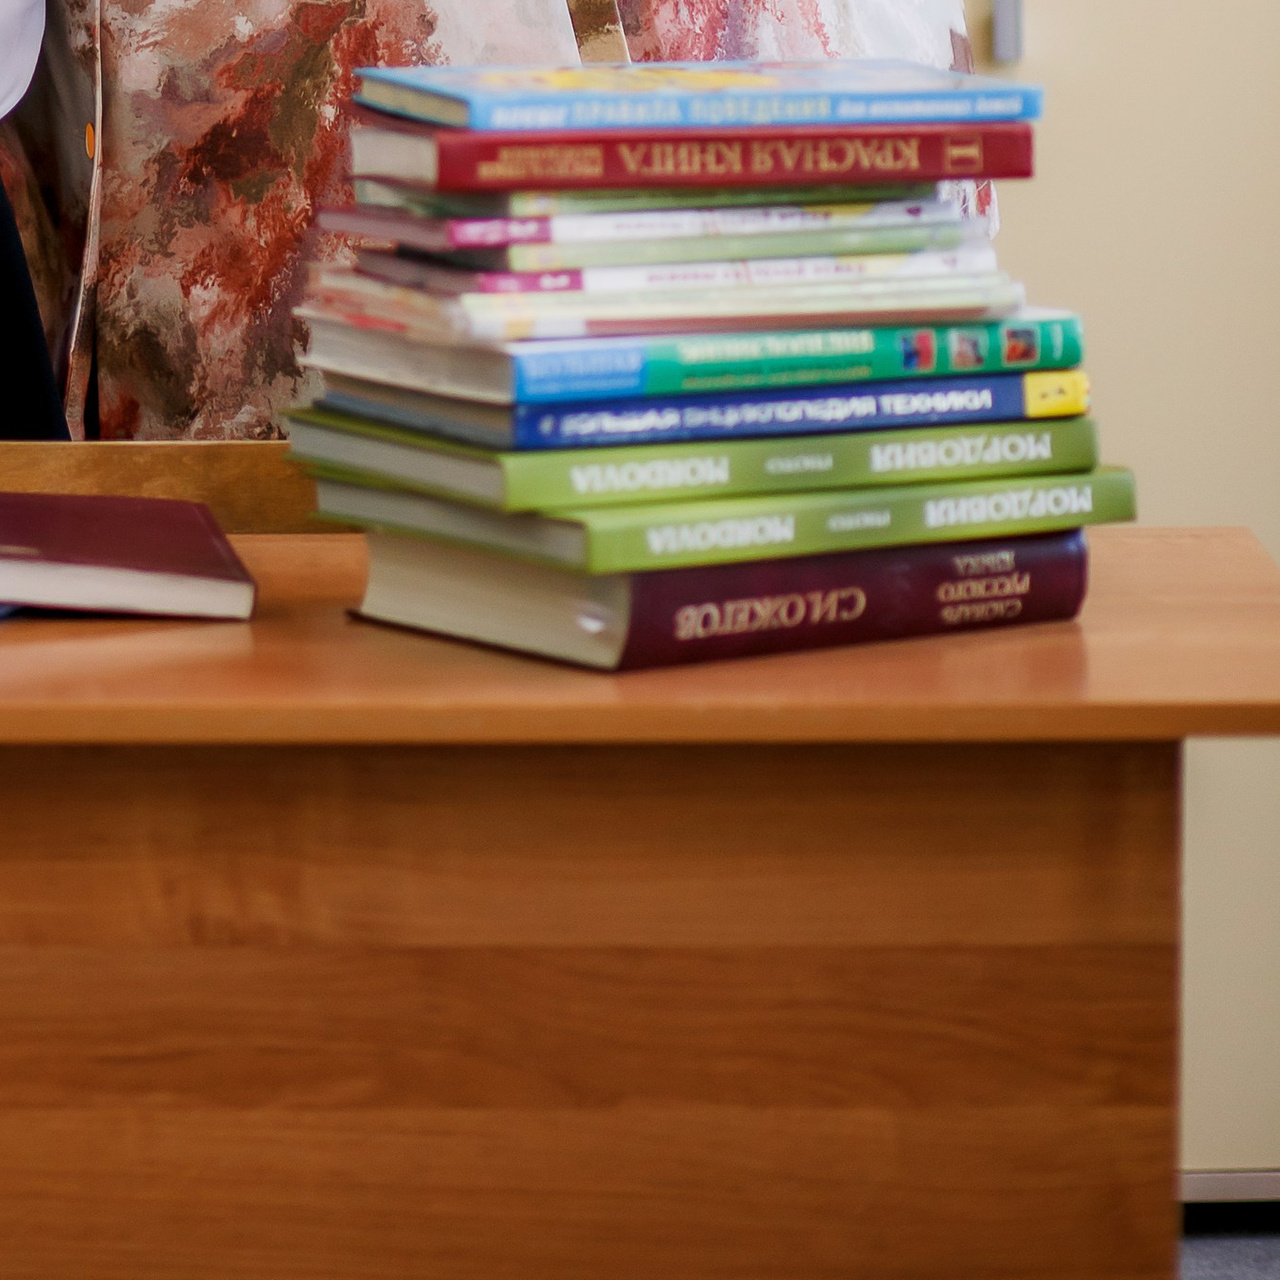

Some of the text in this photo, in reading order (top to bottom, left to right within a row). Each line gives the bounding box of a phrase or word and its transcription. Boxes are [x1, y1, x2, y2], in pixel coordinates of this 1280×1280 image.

[617, 142, 743, 176] КНИГА
[750, 138, 920, 173] КРАСНАЯ
[878, 389, 993, 416] ТЕХНИКИ
[869, 434, 1052, 473] МОРДОВИЯ
[570, 456, 730, 494] MORDOVIA
[925, 486, 1093, 528] МОРДОВИЯ
[646, 516, 795, 555] MORDOVIA
[937, 573, 1031, 603] РУССКОГО
